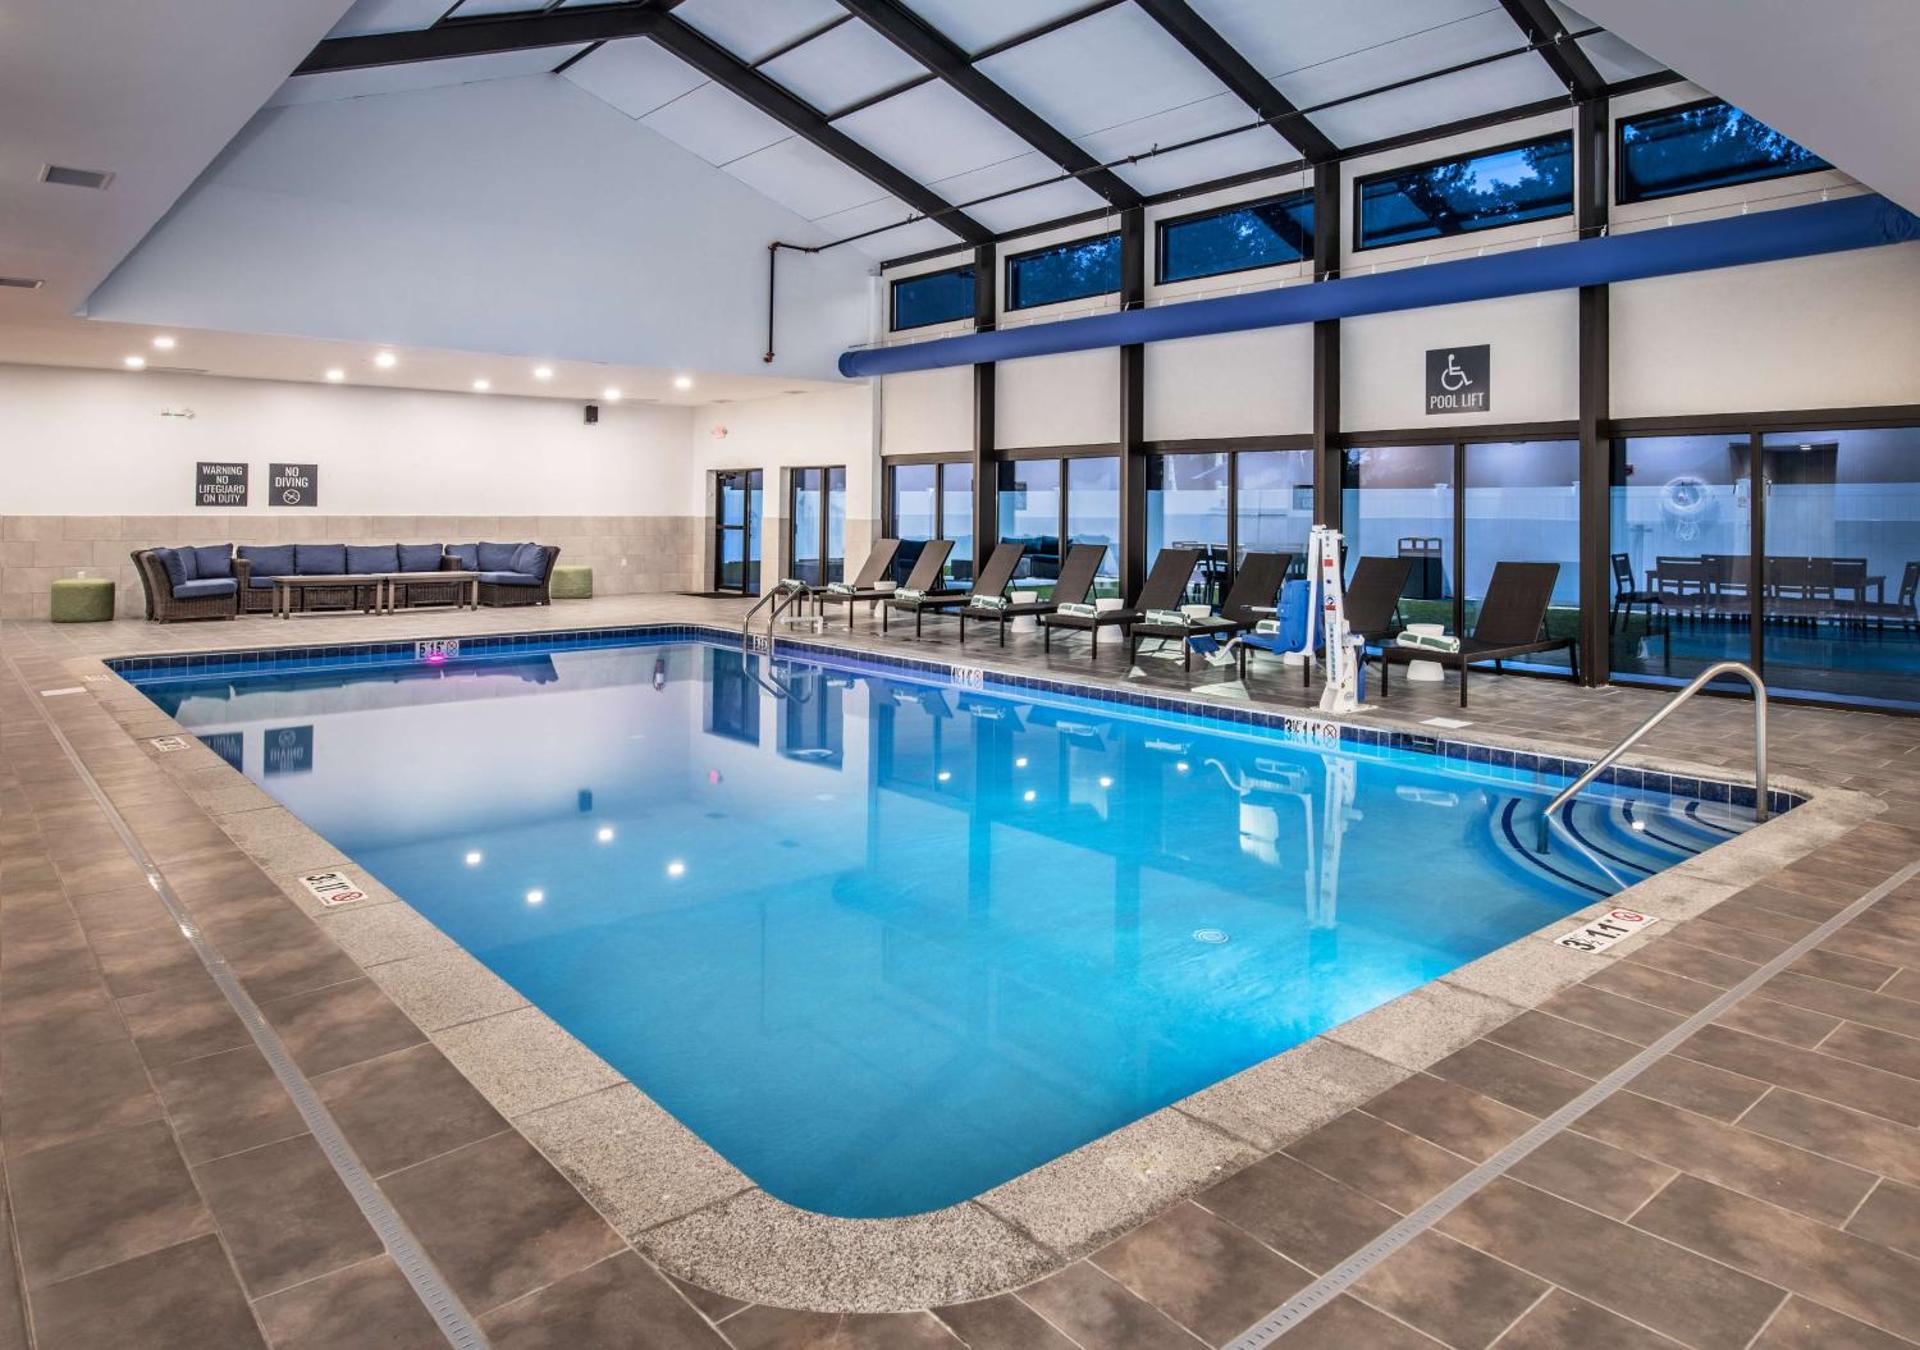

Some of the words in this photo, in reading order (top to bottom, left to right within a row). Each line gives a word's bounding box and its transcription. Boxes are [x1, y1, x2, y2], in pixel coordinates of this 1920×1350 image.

[1430, 394, 1459, 409] POOL
[1462, 392, 1485, 407] LIFT
[202, 465, 243, 476] WARNING
[284, 466, 299, 477] NO
[216, 475, 229, 485] NO
[275, 476, 309, 488] DIVING
[199, 484, 246, 494] LIFEGUARD
[203, 493, 216, 503] ON
[218, 494, 241, 504] DUTY
